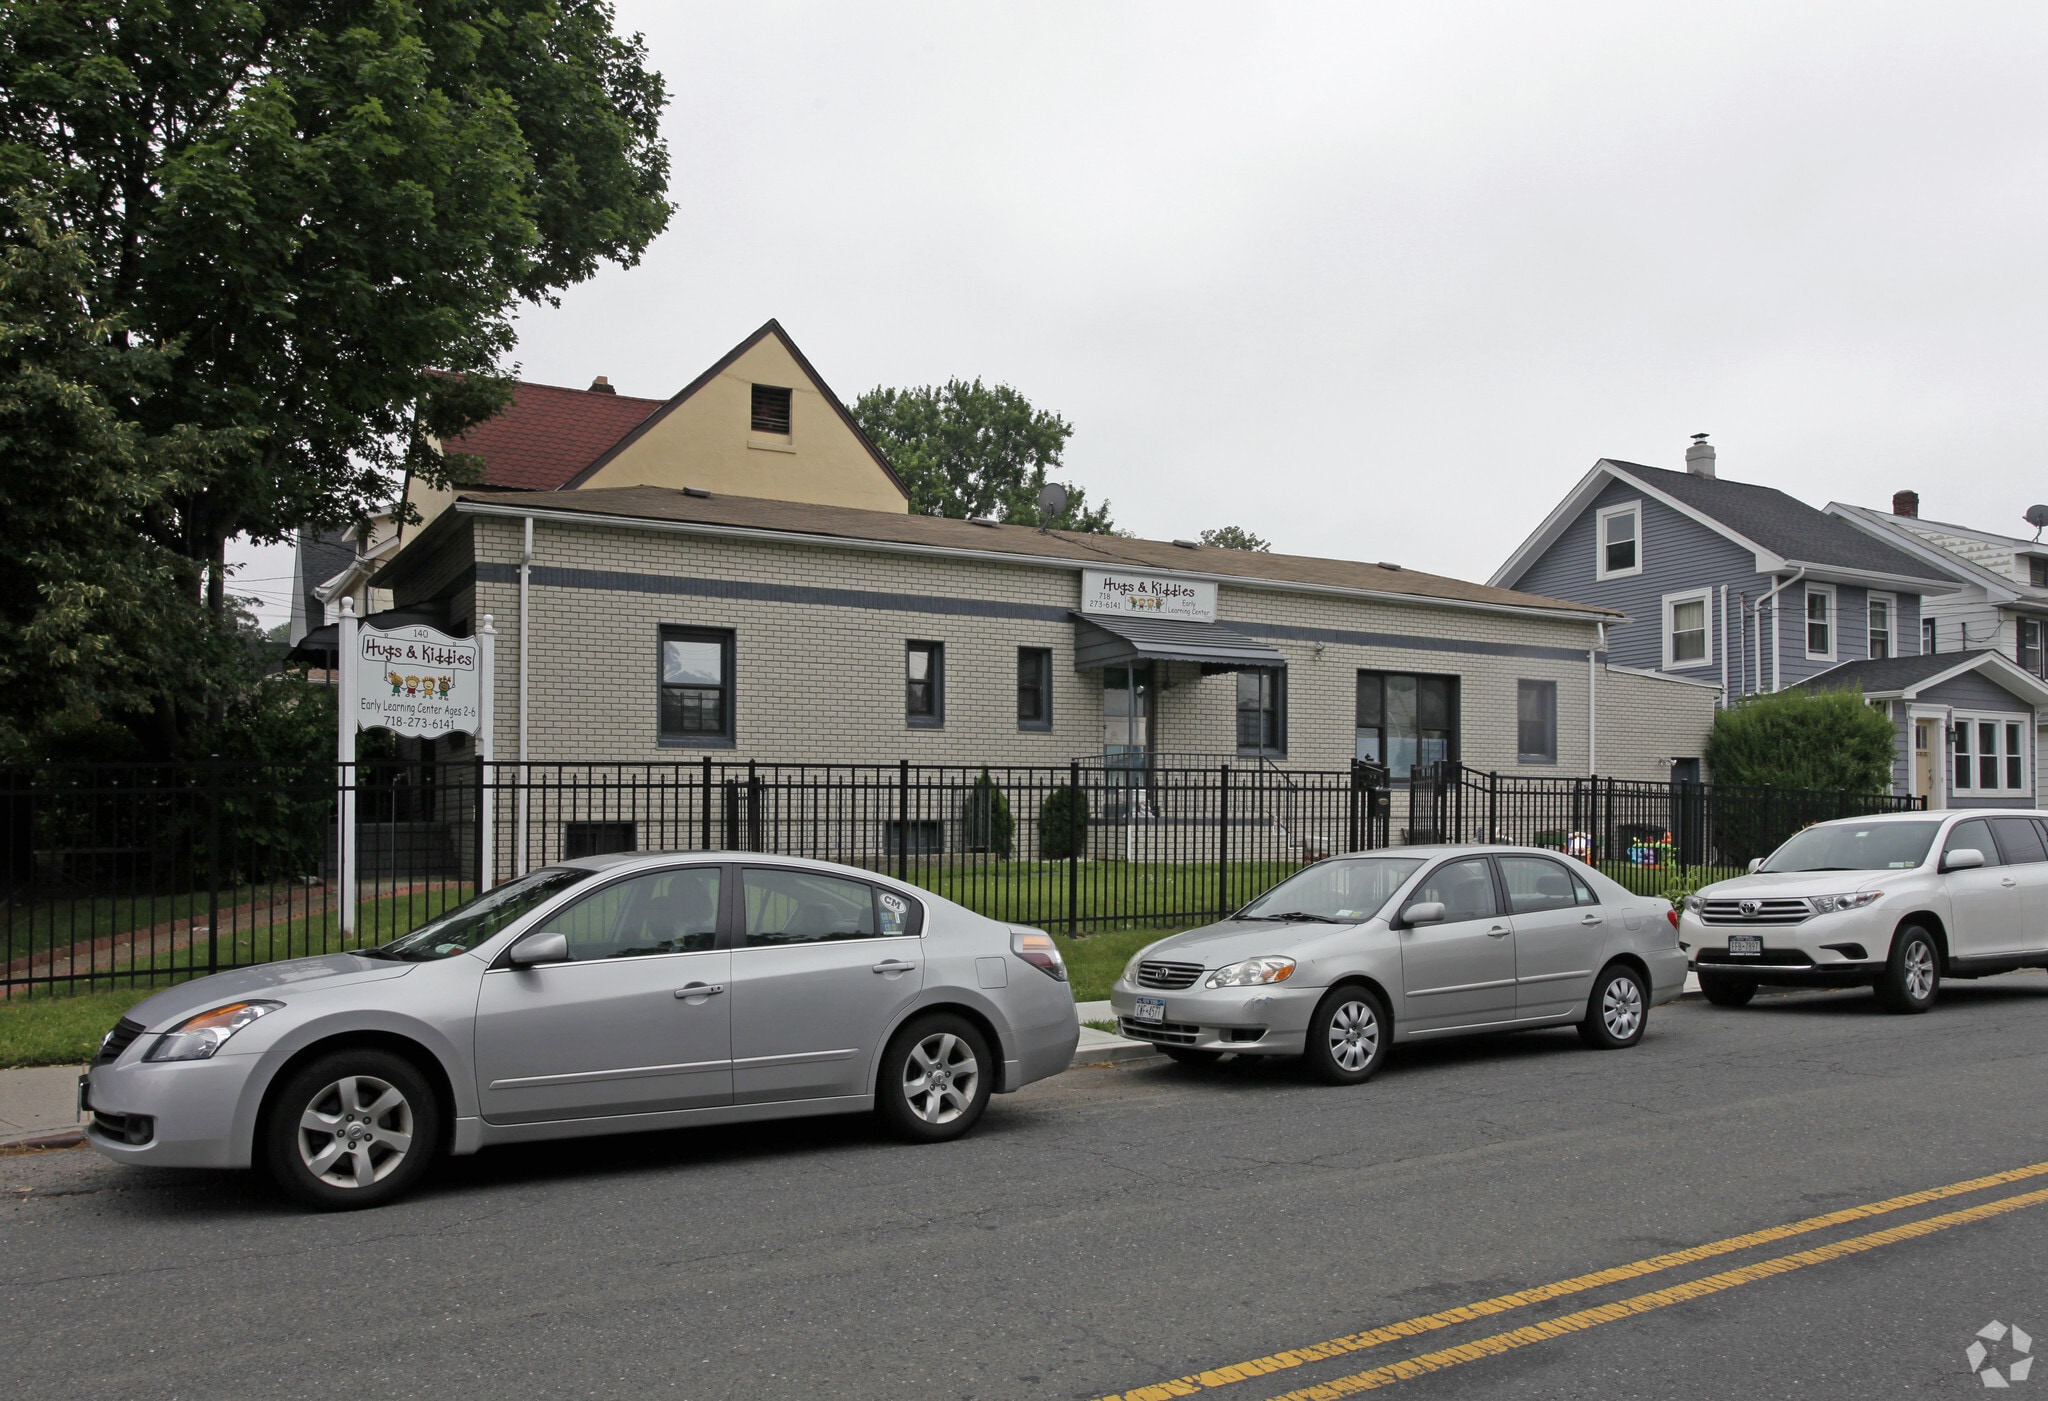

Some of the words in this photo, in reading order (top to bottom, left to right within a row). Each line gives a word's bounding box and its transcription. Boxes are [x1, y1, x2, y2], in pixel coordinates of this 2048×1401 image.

[1103, 577, 1134, 595] Hugs
[1137, 581, 1147, 593] &
[1151, 580, 1195, 597] Kiddies
[1099, 592, 1111, 600] 718
[1089, 600, 1121, 609] 273-6141
[1182, 600, 1196, 608] Early
[1167, 606, 1191, 616] Learning
[1191, 607, 1210, 616] Center
[413, 629, 429, 638] 140
[365, 638, 402, 662] Hugs
[406, 645, 418, 660] &
[422, 644, 472, 665] Kiddies
[361, 698, 381, 713] Early
[383, 700, 416, 716] Learning
[417, 703, 443, 715] Center
[444, 705, 462, 719] Ages
[463, 706, 476, 717] 2-6
[384, 716, 455, 730] 718-273-6141
[884, 895, 902, 910] CM
